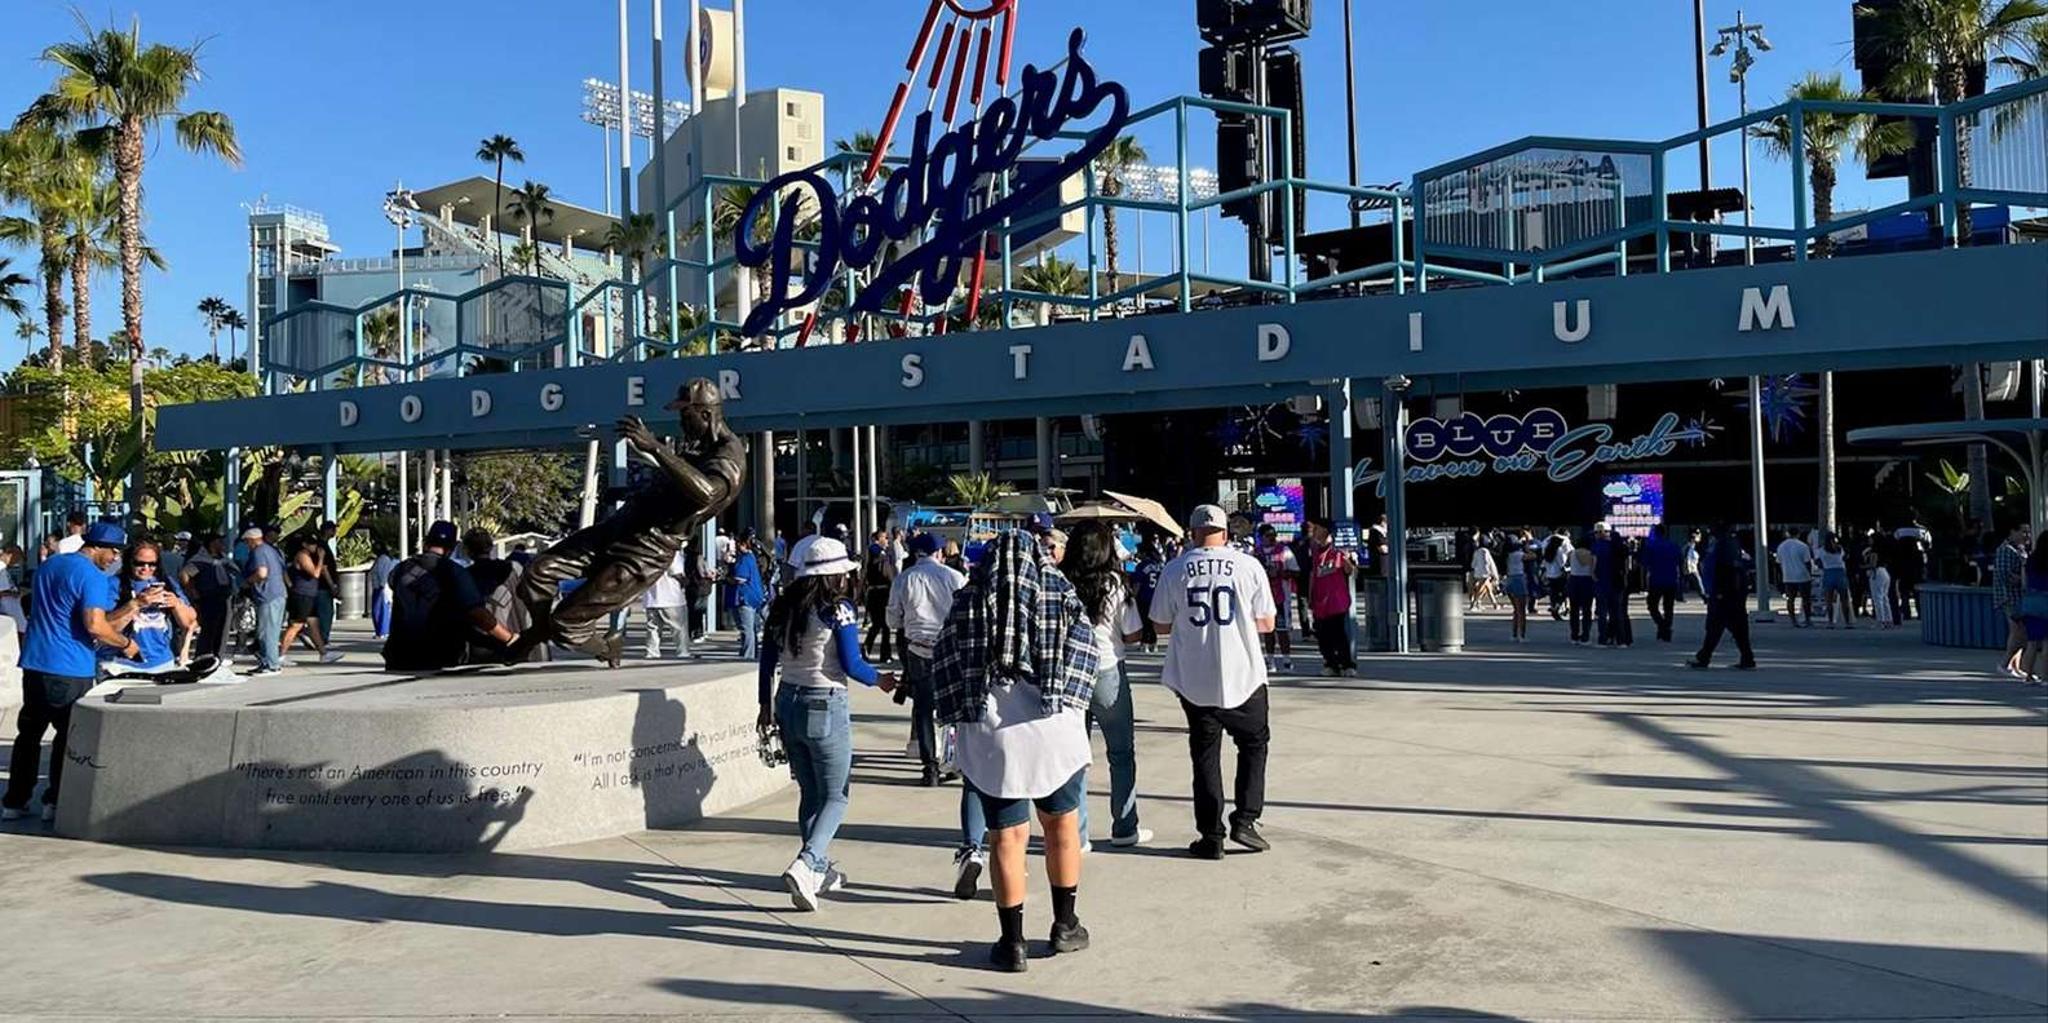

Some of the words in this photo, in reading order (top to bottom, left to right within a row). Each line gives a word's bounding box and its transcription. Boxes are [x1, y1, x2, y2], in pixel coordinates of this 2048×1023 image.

[735, 27, 1130, 337] Dodgers
[340, 369, 742, 427] DODGER
[902, 285, 1796, 388] STADIUM
[1412, 420, 1557, 449] BLUE
[1492, 453, 1537, 473] on
[1546, 413, 1680, 482] Earth
[1186, 559, 1234, 577] BETTS
[1187, 586, 1235, 627] 50
[235, 762, 297, 780] "There's
[299, 766, 324, 780] not
[326, 767, 346, 780] an
[351, 765, 425, 781] American
[429, 764, 445, 779] in
[449, 762, 477, 778] this
[480, 760, 544, 778] country
[607, 749, 627, 763] not
[591, 773, 609, 790] All
[654, 763, 675, 778] that
[678, 761, 696, 777] you
[266, 787, 297, 805] free
[299, 788, 330, 806] until
[332, 793, 378, 809] every
[382, 792, 410, 807] one
[416, 788, 433, 808] of
[435, 792, 455, 804] us
[459, 791, 471, 804] is
